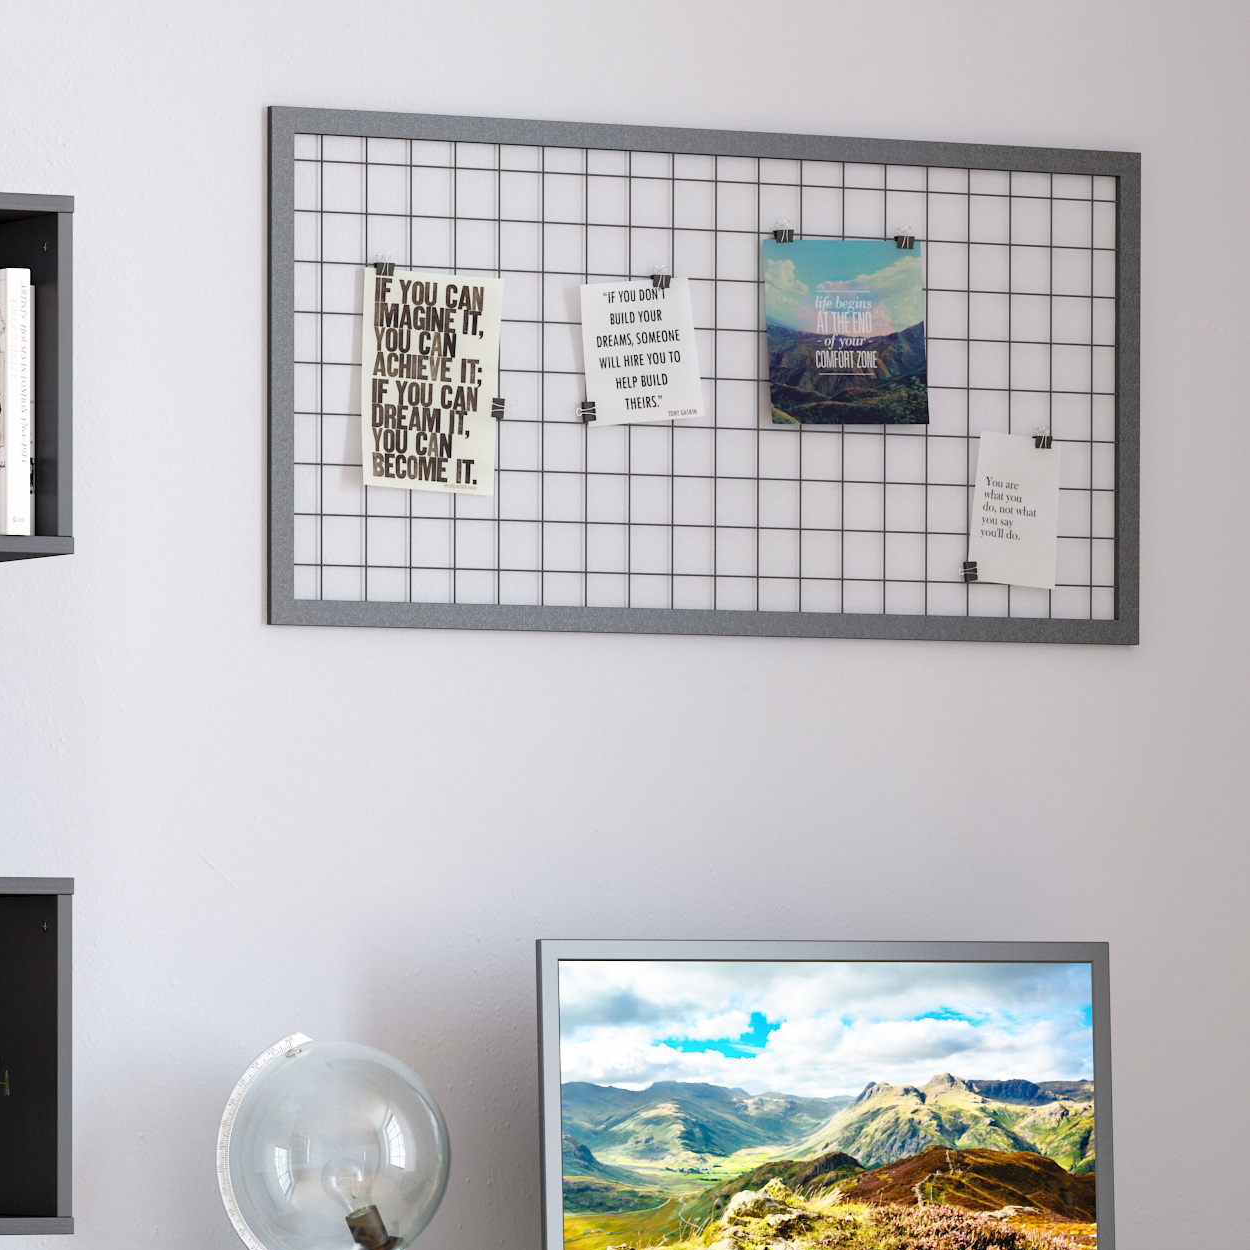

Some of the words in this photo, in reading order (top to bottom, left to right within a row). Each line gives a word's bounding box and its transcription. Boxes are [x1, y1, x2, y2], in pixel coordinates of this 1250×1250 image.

[374, 277, 393, 302] IF
[399, 279, 438, 306] YOU
[445, 284, 484, 311] CAN
[618, 289, 636, 303] YOU
[815, 295, 832, 312] life
[835, 295, 872, 313] begins
[374, 302, 457, 333] IMAGINE
[462, 309, 484, 339] IT,
[610, 311, 635, 325] BUILD
[638, 309, 662, 322] YOUR
[816, 311, 829, 333] AT
[831, 311, 850, 334] THE
[853, 311, 872, 334] END
[374, 327, 411, 353] YOU
[418, 331, 456, 358] CAN
[596, 333, 634, 348] DREAMS,
[636, 329, 680, 345] SOMEONE
[824, 333, 839, 350] of
[838, 337, 867, 350] your
[599, 356, 621, 369] WILL
[624, 353, 644, 367] HIRE
[647, 351, 666, 365] YOU
[669, 350, 681, 363] TO
[815, 350, 854, 369] COMFORT
[856, 350, 878, 369] ZONE
[373, 352, 452, 382] ACHIEVE
[461, 358, 482, 387] IT;
[615, 375, 638, 389] HELP
[640, 373, 668, 387] BUILD
[371, 378, 389, 403] IF
[395, 380, 433, 407] YOU
[440, 385, 478, 412] CAN
[371, 403, 441, 433] DREAM
[448, 409, 470, 439] IT,
[681, 408, 698, 416] GASKIN
[372, 428, 408, 454] YOU
[415, 431, 453, 458] CAN
[372, 452, 448, 483] BECOME
[456, 459, 477, 484] IT.
[986, 476, 1003, 488] You
[1005, 481, 1019, 490] are
[984, 489, 1004, 501] what
[1006, 494, 1022, 504] you
[982, 501, 997, 513] do,
[999, 506, 1014, 515] not
[1016, 506, 1037, 517] what
[981, 516, 998, 526] you
[1000, 519, 1014, 529] say
[980, 528, 1004, 538] you'll
[1005, 529, 1021, 540] do.
